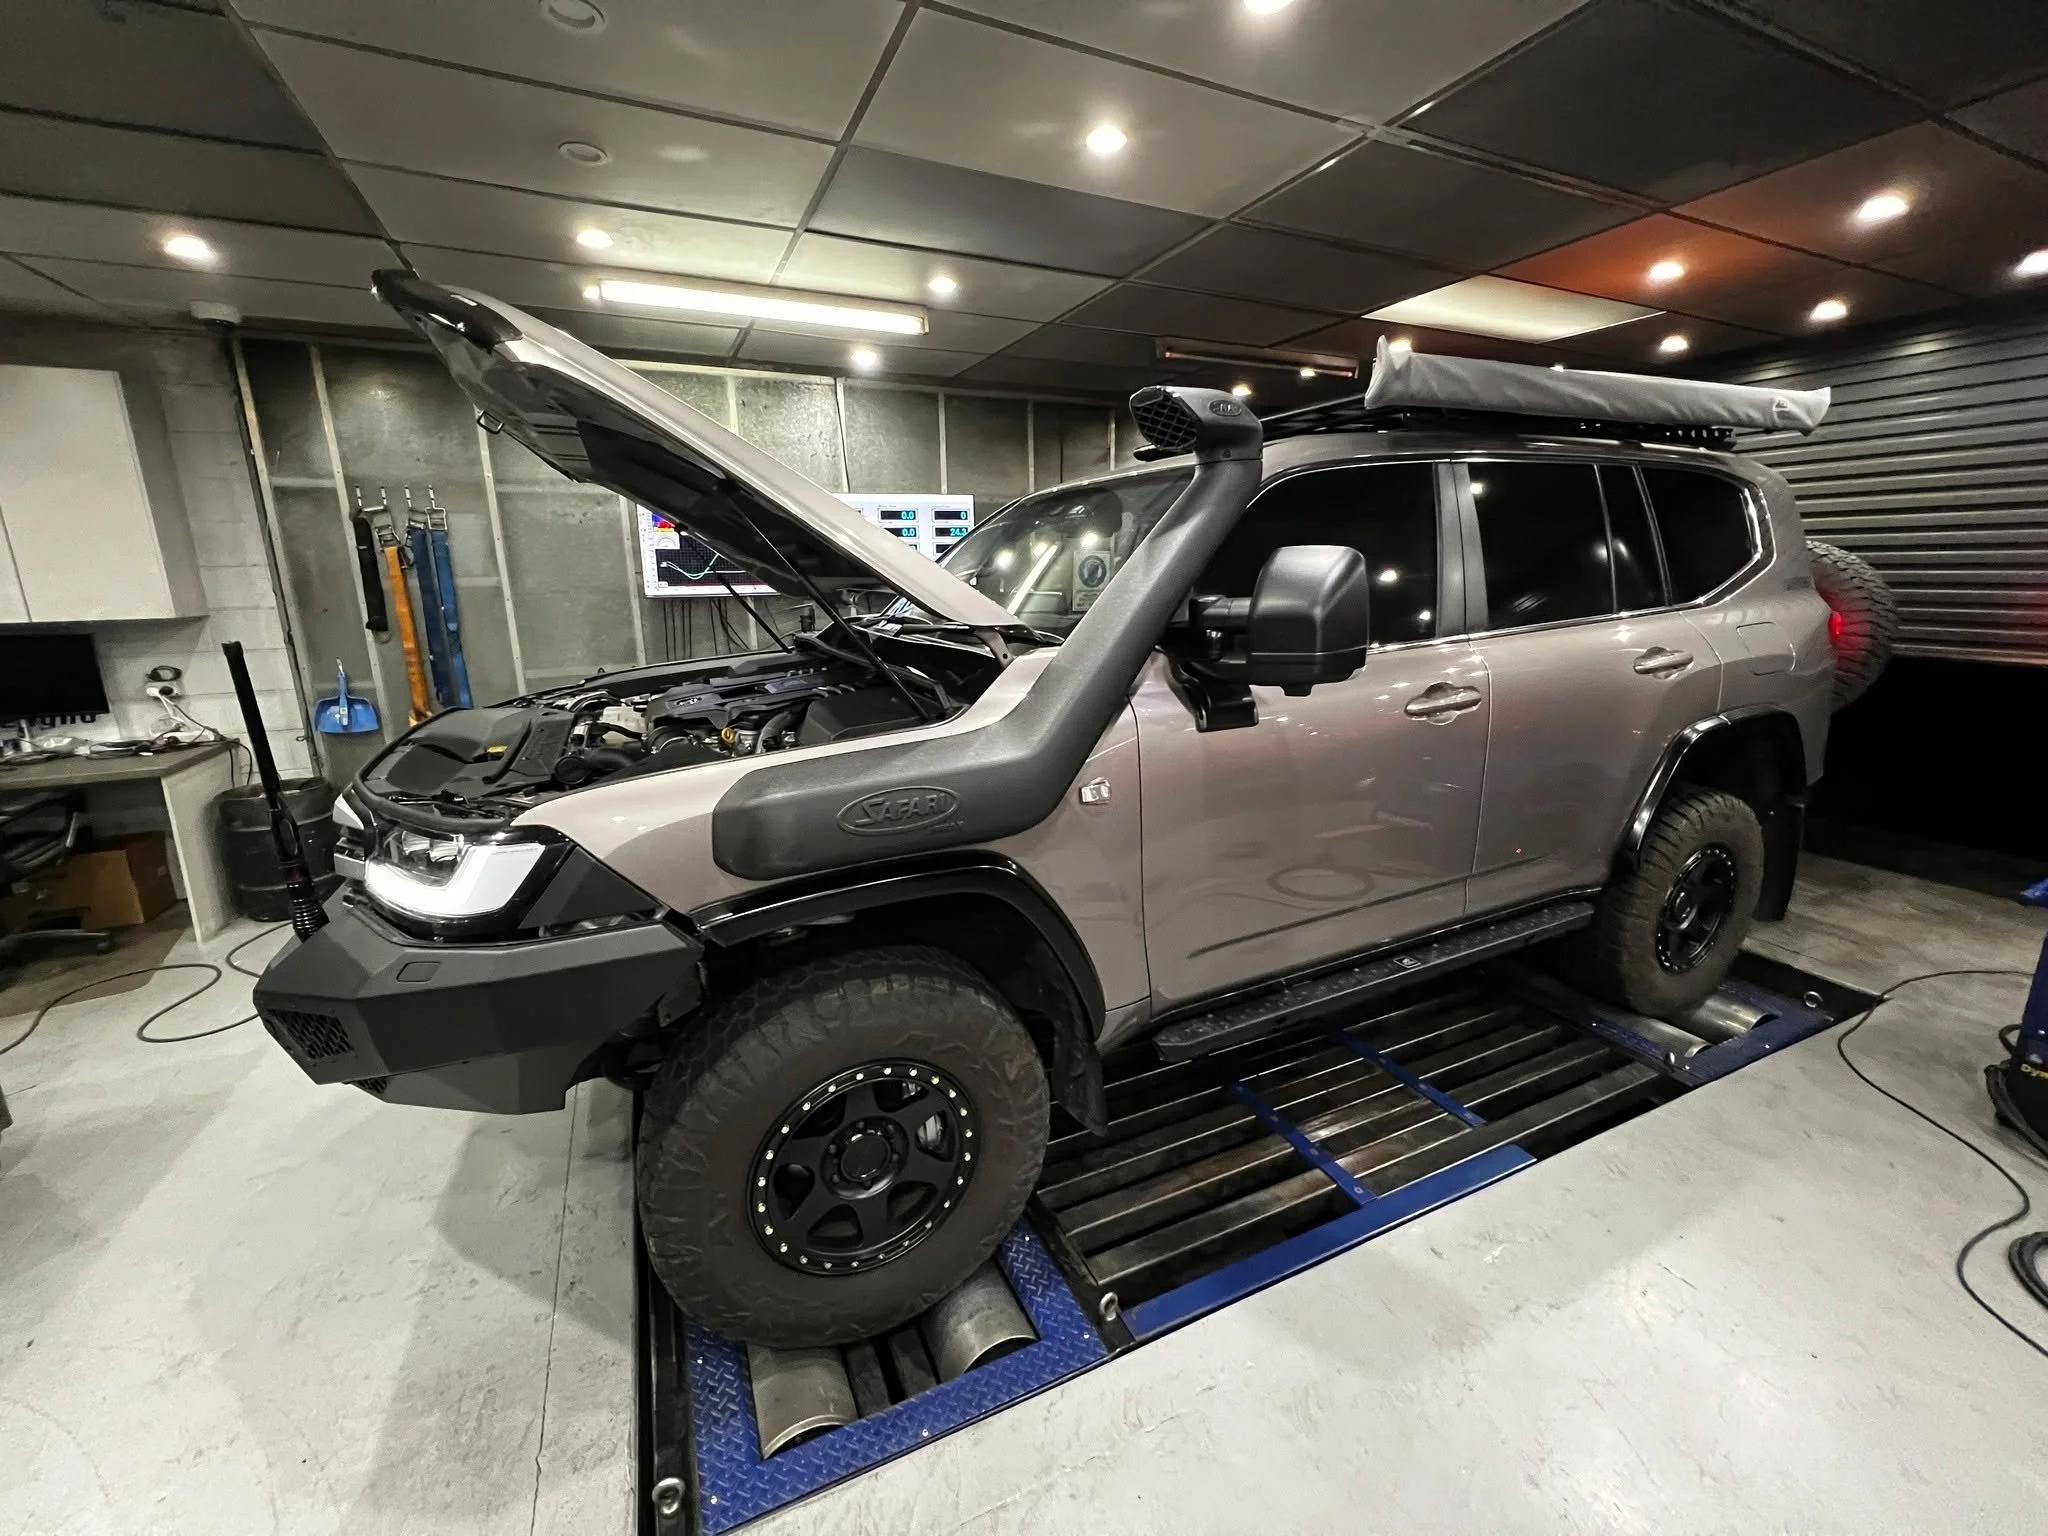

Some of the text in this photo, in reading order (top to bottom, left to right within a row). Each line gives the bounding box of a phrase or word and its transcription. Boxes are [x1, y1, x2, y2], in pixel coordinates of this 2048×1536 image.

[901, 511, 914, 519] 0.0
[960, 511, 966, 519] 0
[902, 528, 915, 536] 0.0
[950, 528, 967, 536] 24.3
[855, 793, 947, 826] SAFARI
